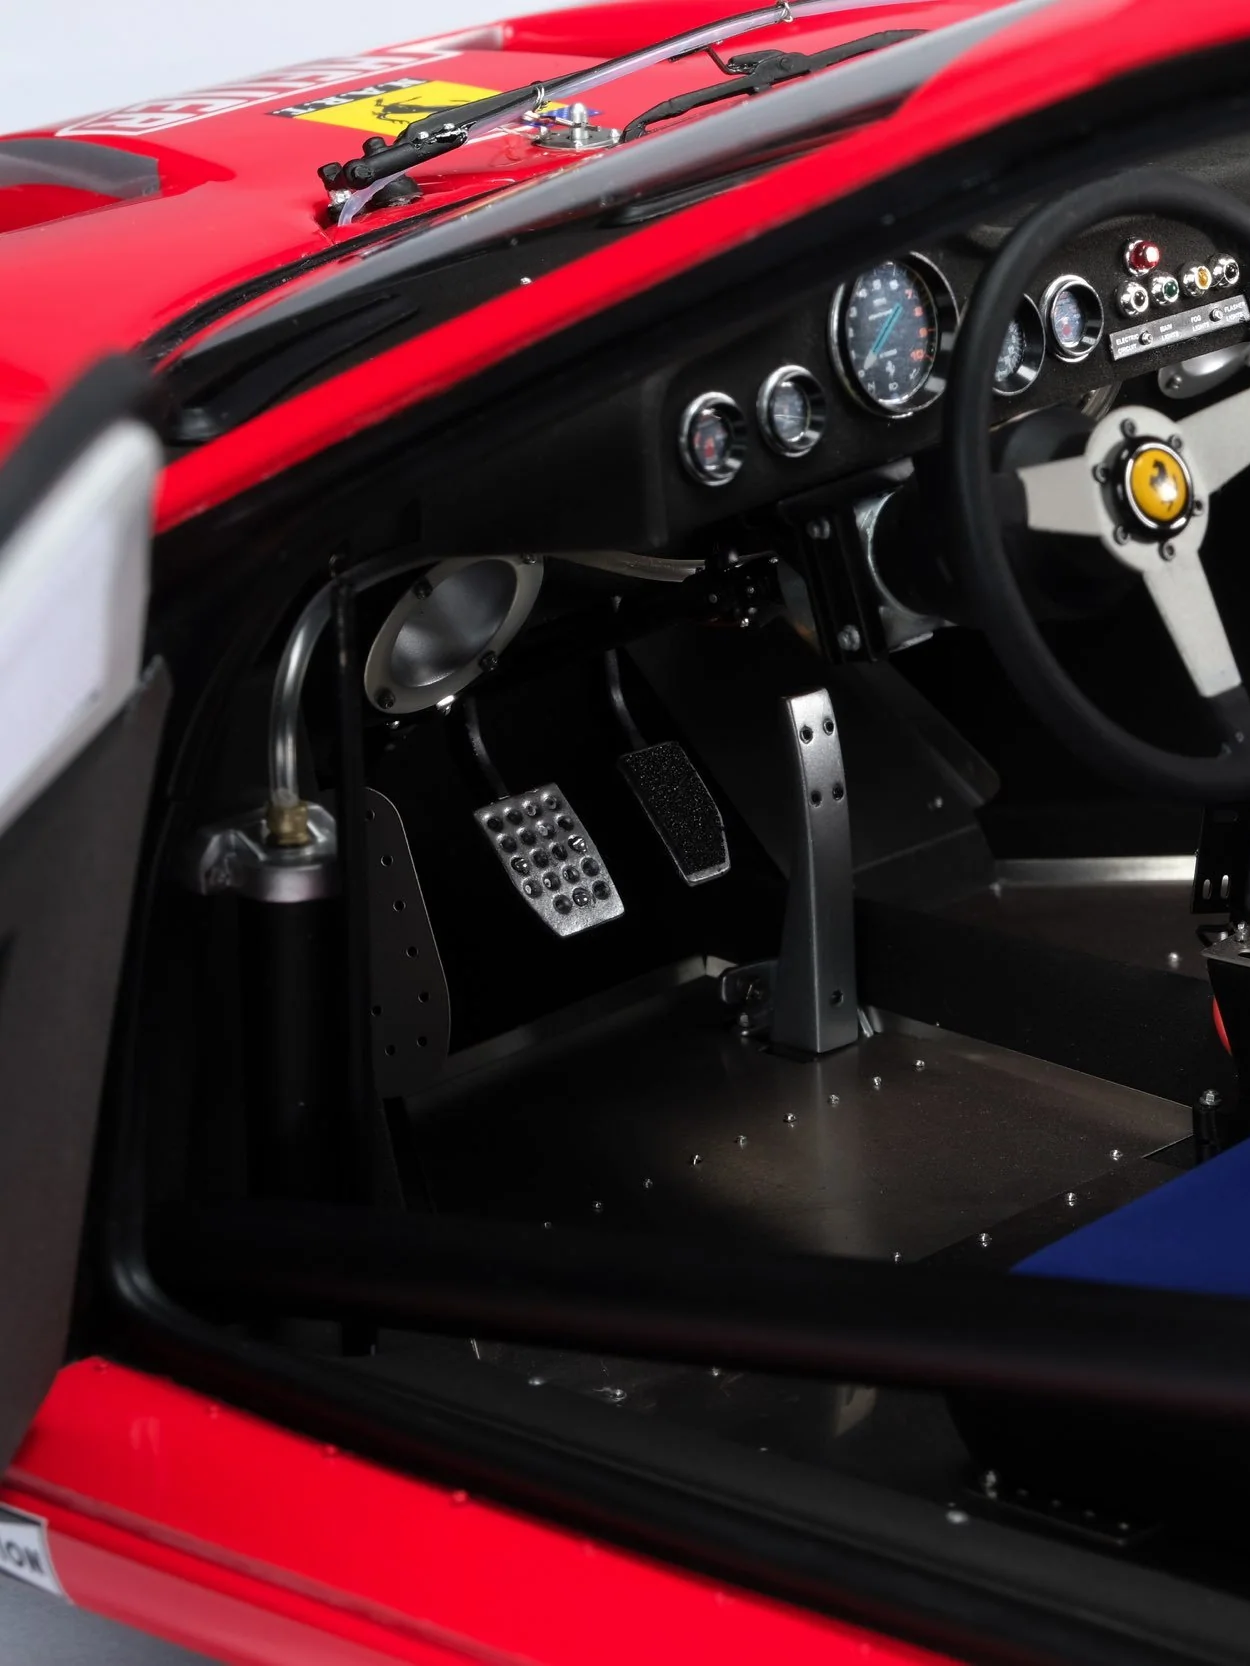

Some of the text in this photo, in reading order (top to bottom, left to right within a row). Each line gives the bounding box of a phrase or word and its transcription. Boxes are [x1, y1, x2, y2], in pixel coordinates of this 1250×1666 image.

[1190, 314, 1202, 324] FOG
[1192, 321, 1210, 332] LIGHTS
[1115, 333, 1140, 345] ELECTRIC
